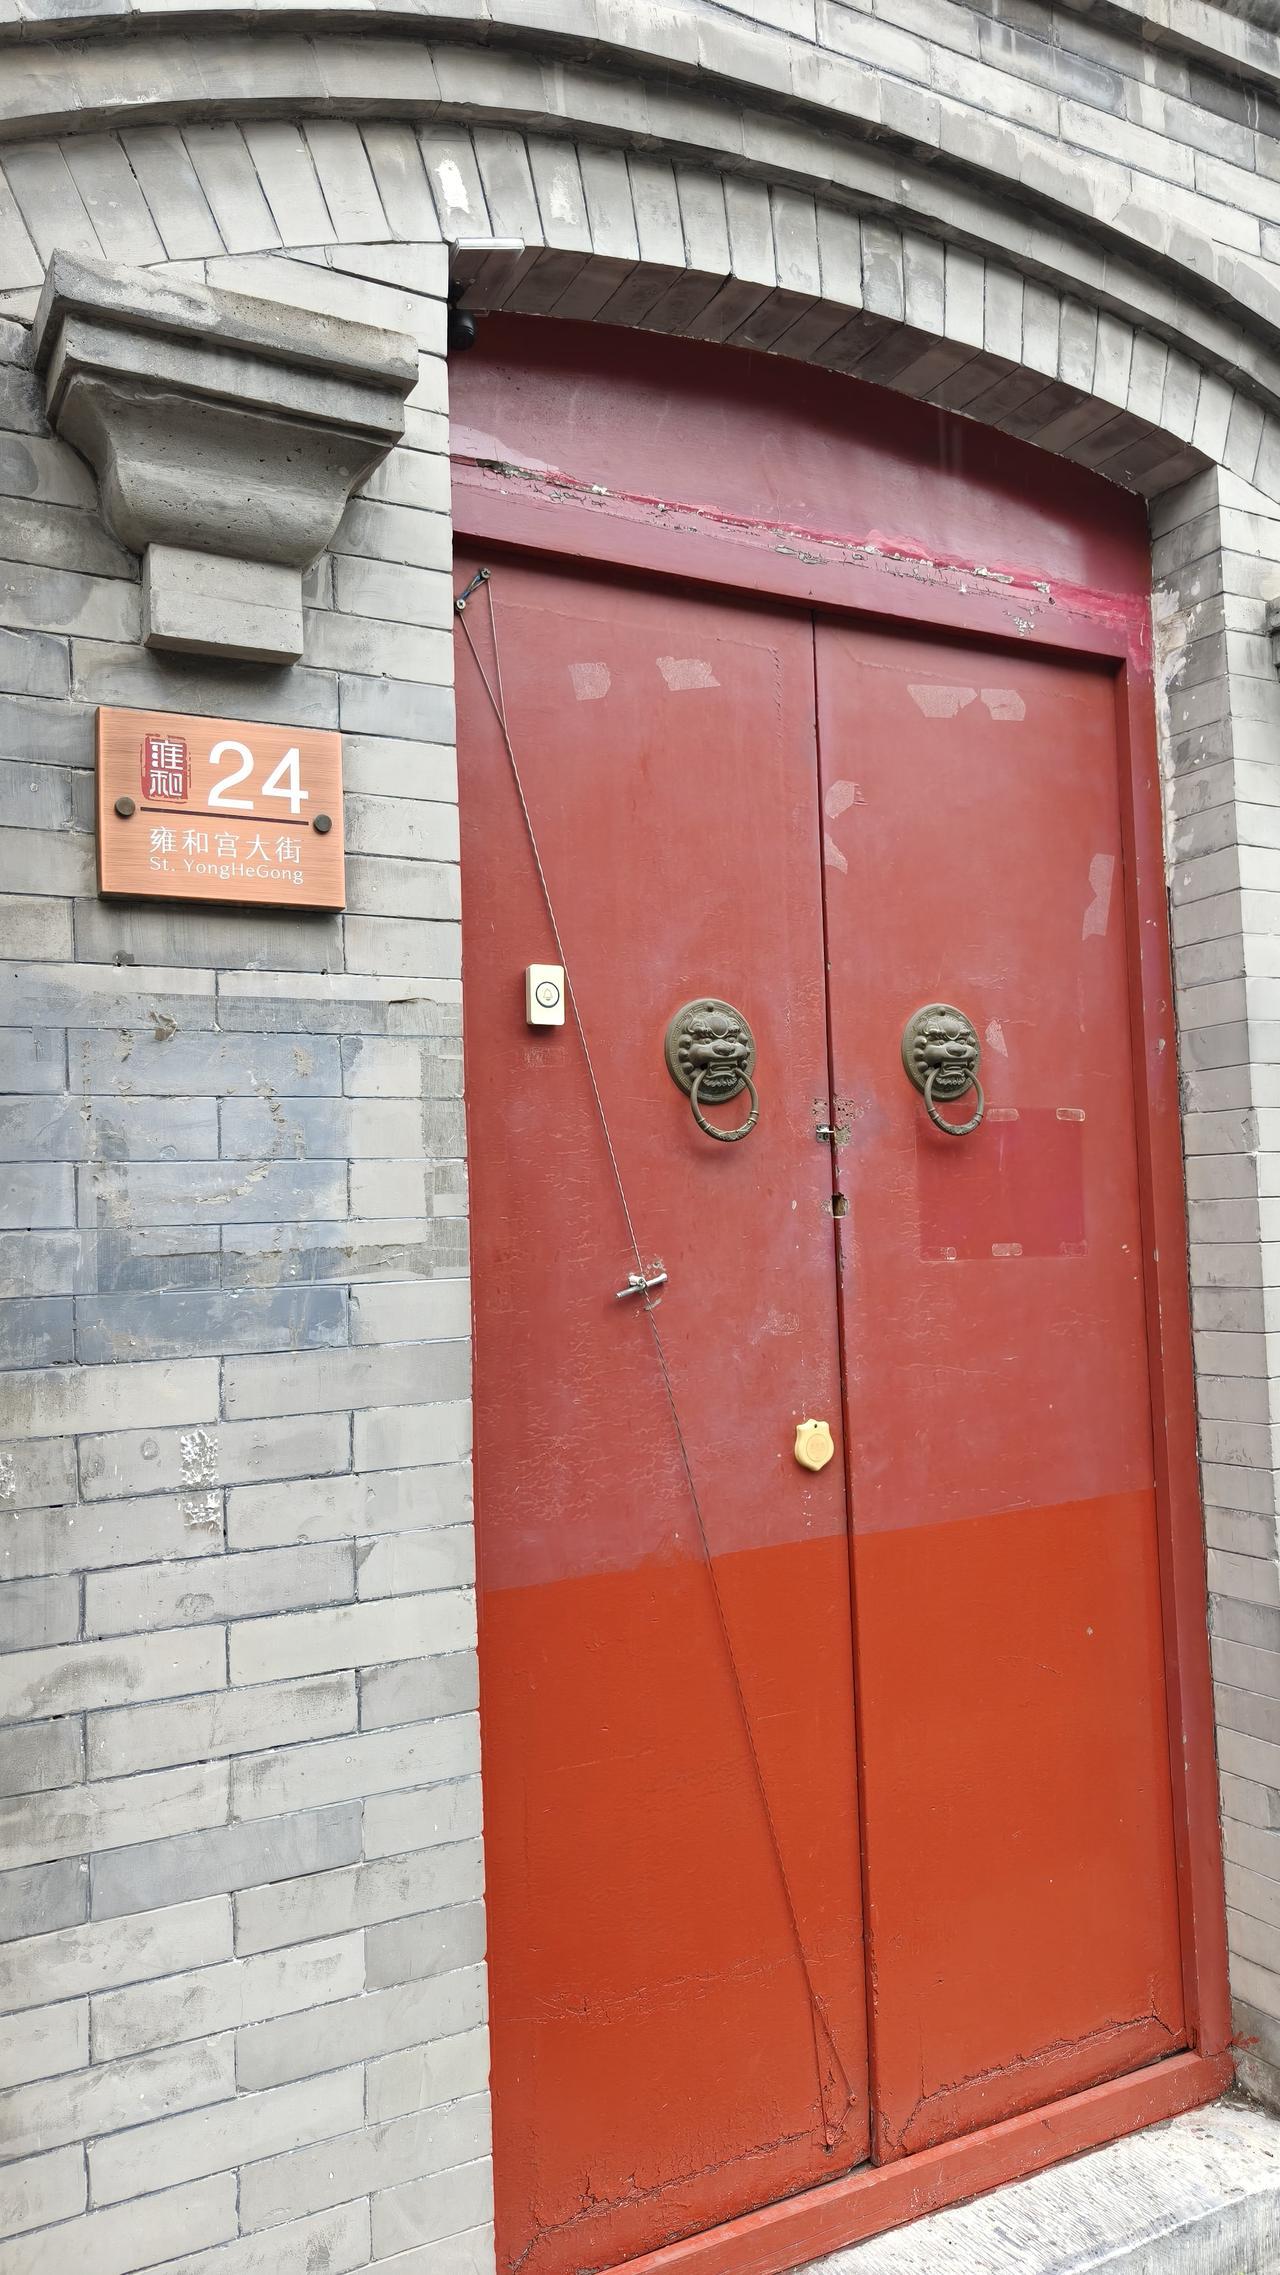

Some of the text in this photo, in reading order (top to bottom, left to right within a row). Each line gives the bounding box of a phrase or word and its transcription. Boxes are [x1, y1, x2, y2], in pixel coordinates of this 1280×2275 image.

[207, 740, 309, 814] 24
[149, 826, 303, 864] 雍和宫大街
[149, 856, 304, 885] St. YongHeGong
